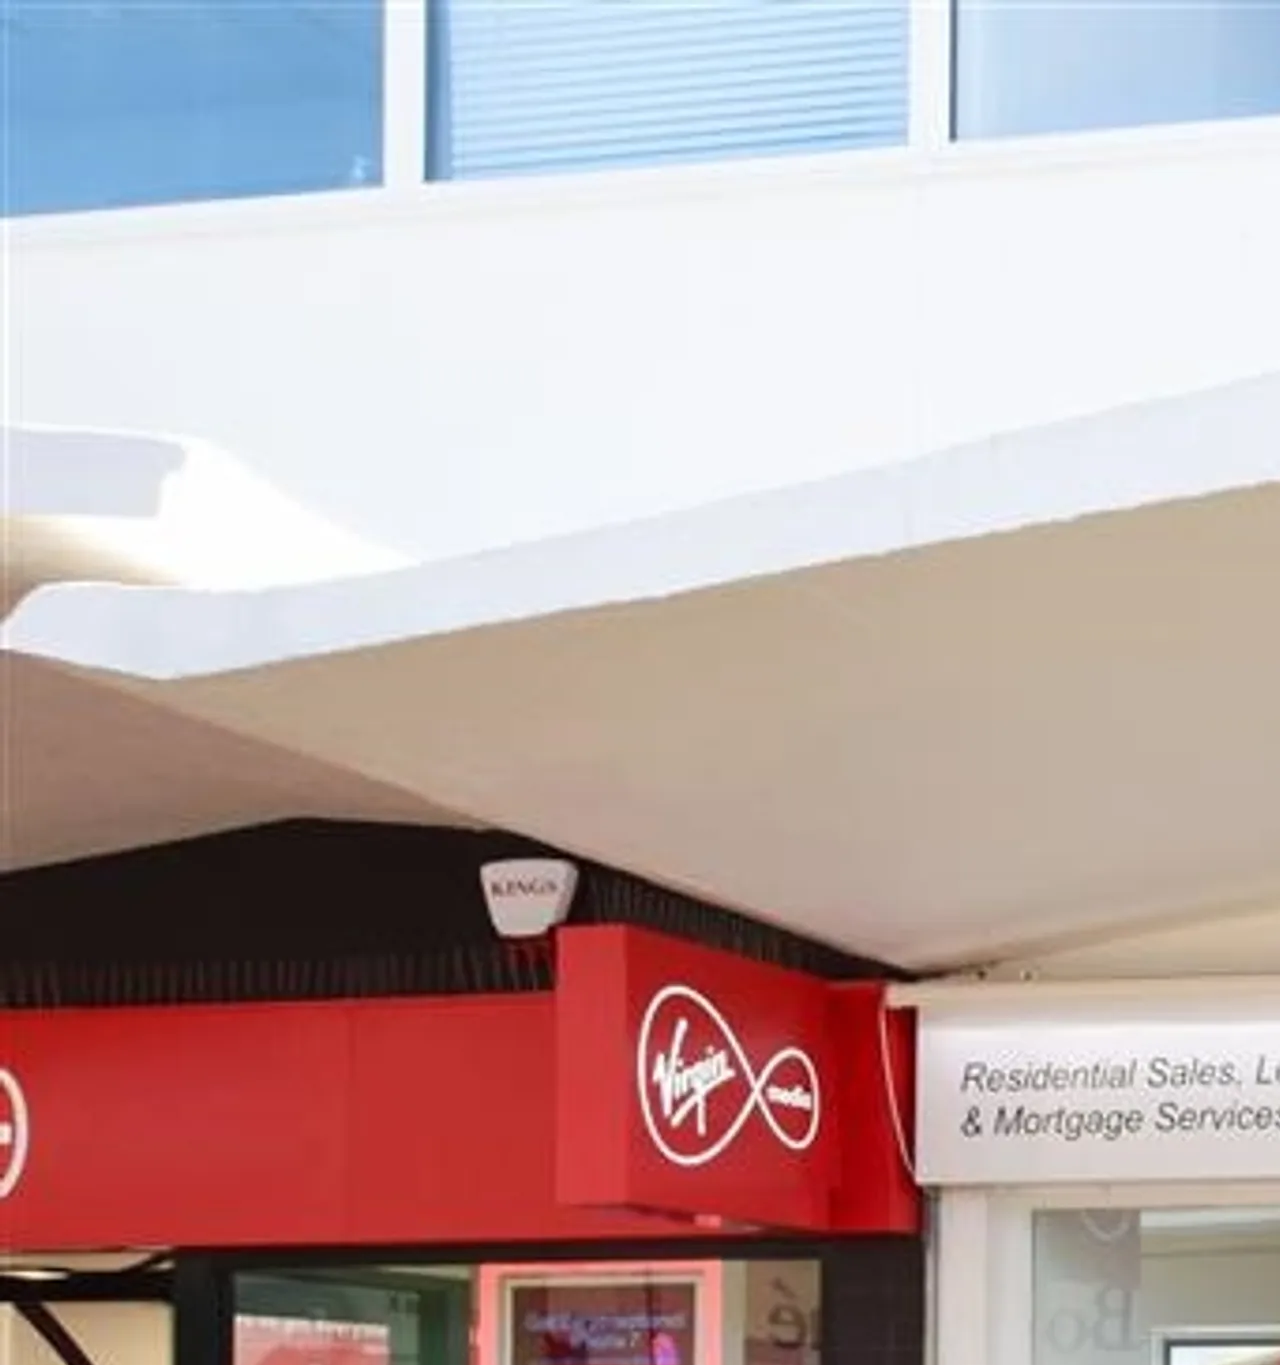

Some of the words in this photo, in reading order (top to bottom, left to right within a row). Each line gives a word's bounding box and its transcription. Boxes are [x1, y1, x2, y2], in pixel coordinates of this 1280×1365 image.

[652, 1016, 736, 1137] Virgin
[960, 1057, 1136, 1091] Residential
[1146, 1056, 1242, 1089] Sales,
[959, 1106, 983, 1138] &
[993, 1106, 1144, 1142] Mortgage
